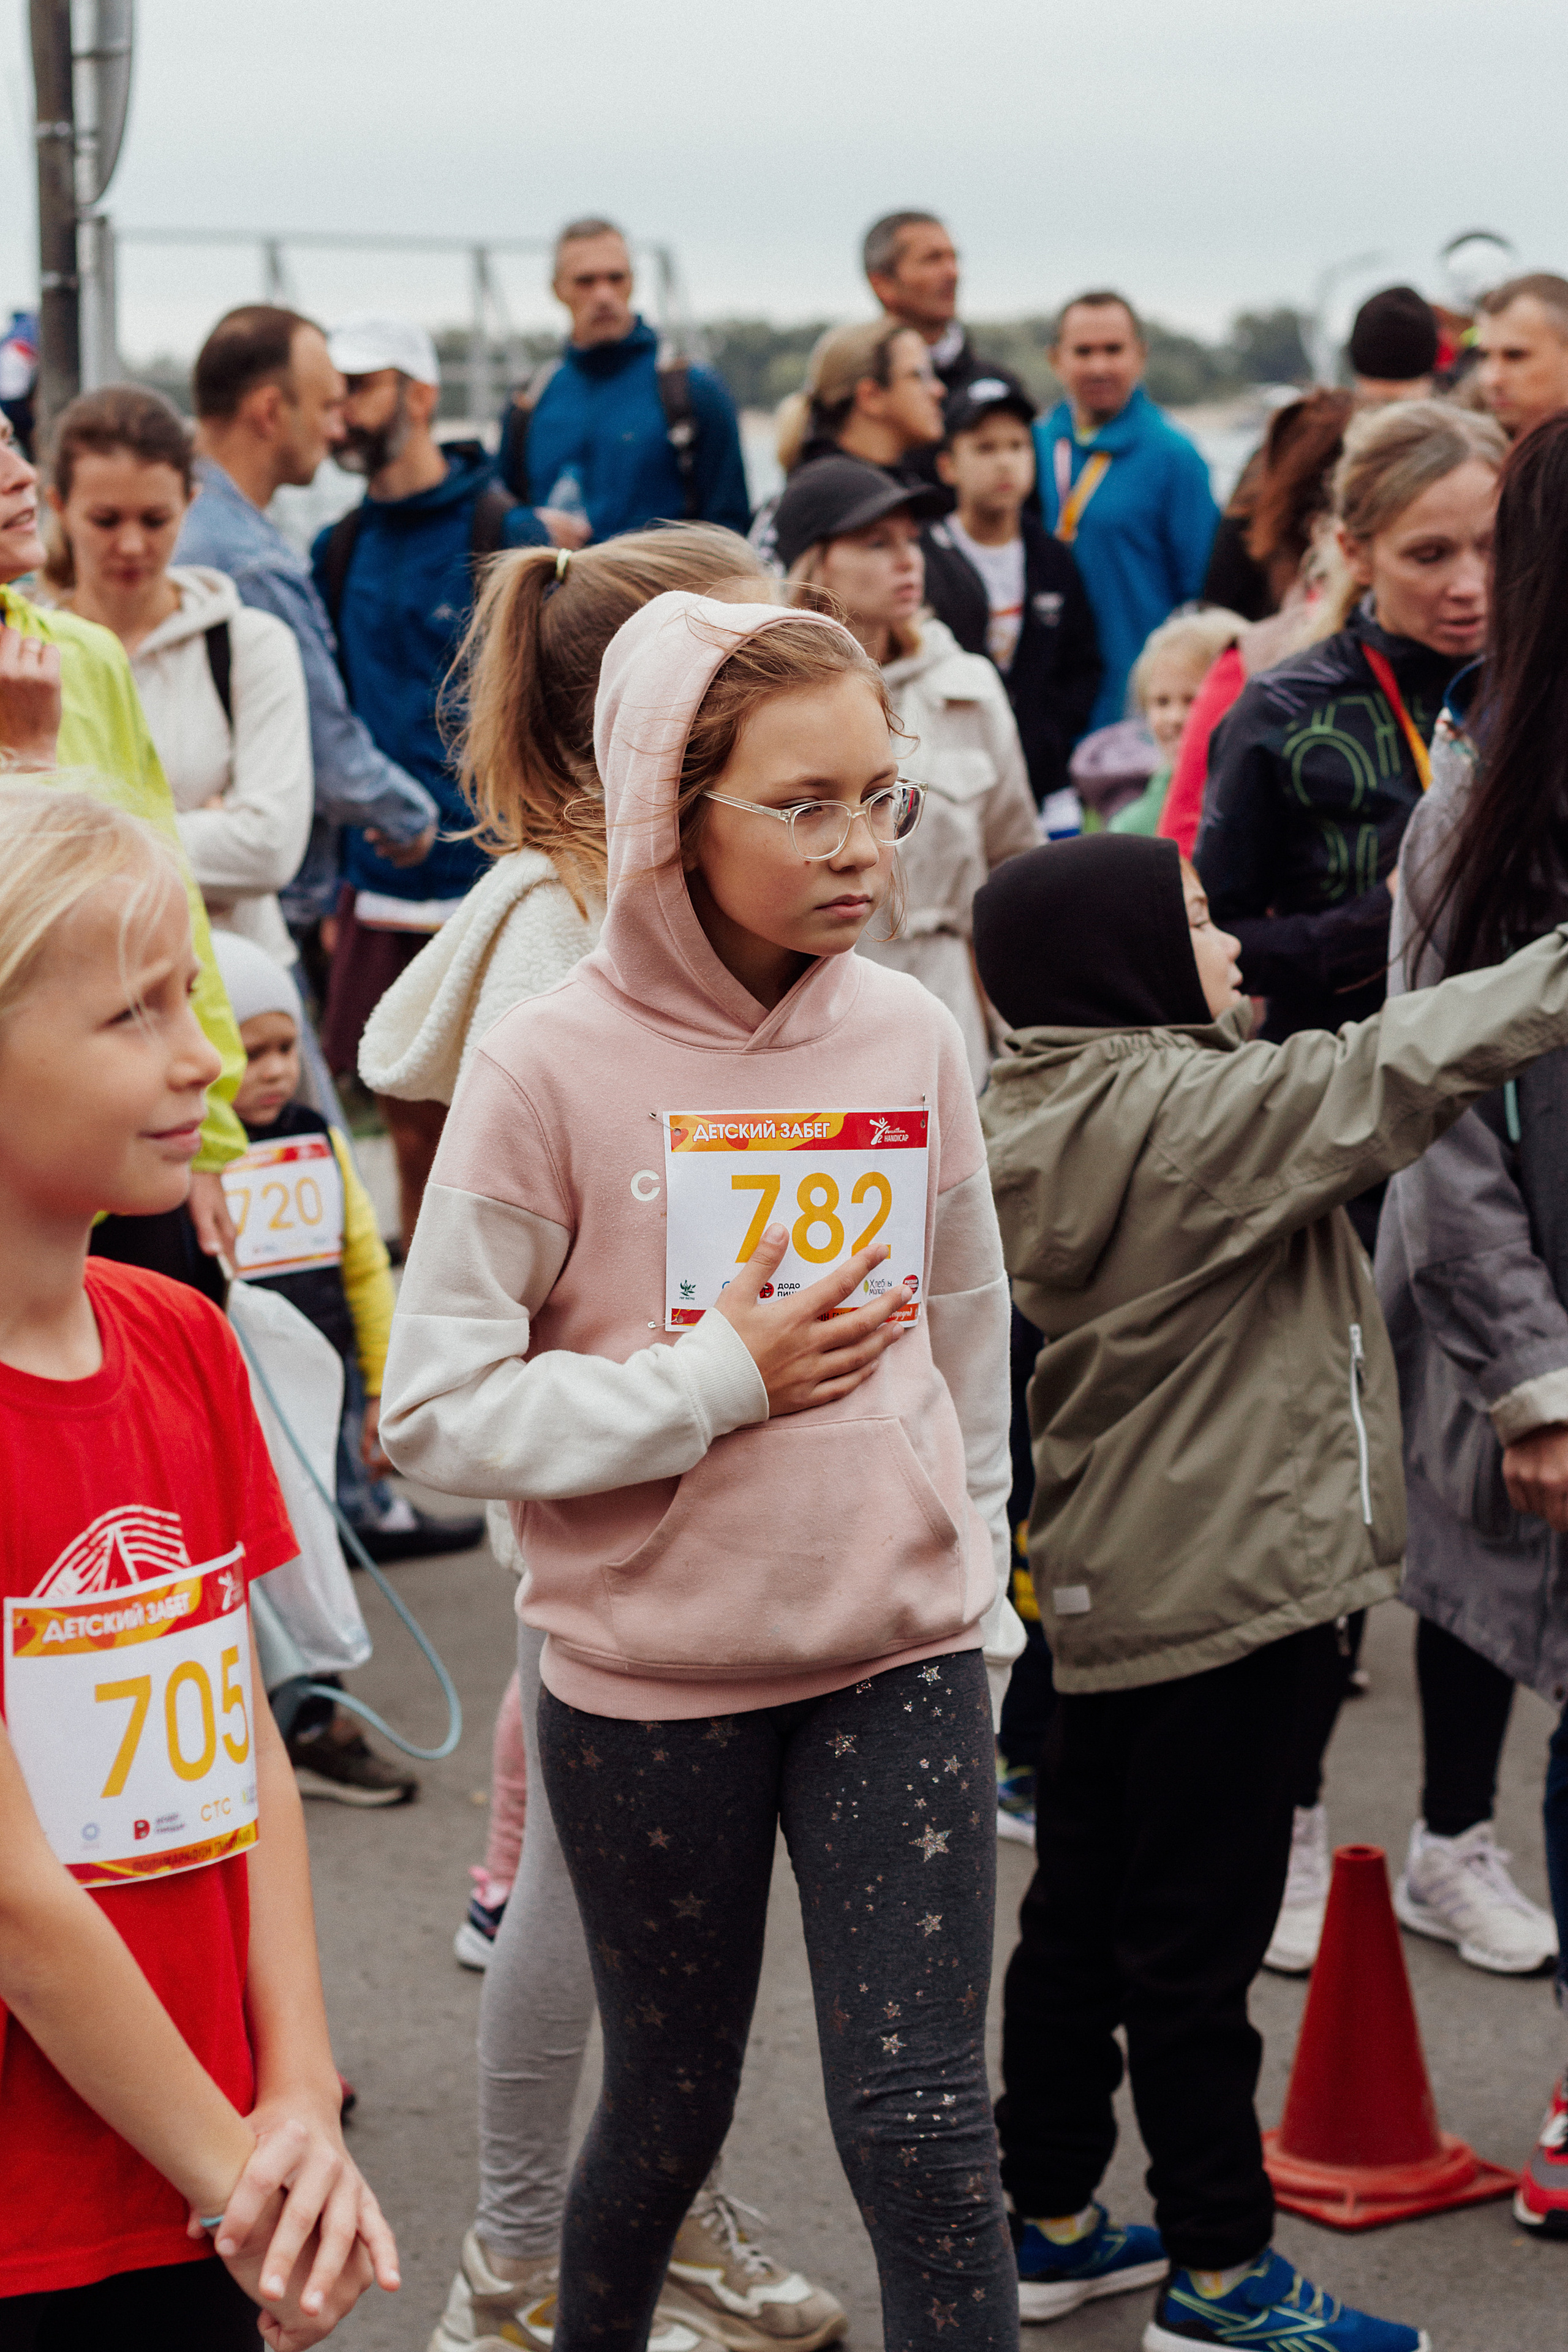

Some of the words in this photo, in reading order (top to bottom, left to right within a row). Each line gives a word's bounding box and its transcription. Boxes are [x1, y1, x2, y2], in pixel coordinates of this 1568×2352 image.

[693, 1120, 776, 1142] ДЕТСКИЙ
[780, 1123, 831, 1139] ЗАБЕГ
[884, 1134, 909, 1142] HANDICAP
[224, 1177, 323, 1235] 720
[731, 1171, 892, 1264] 782
[42, 1601, 145, 1644] ДЕТСКИЙ
[146, 1593, 190, 1624] ЗАБЕГ
[95, 1645, 250, 1798] 705
